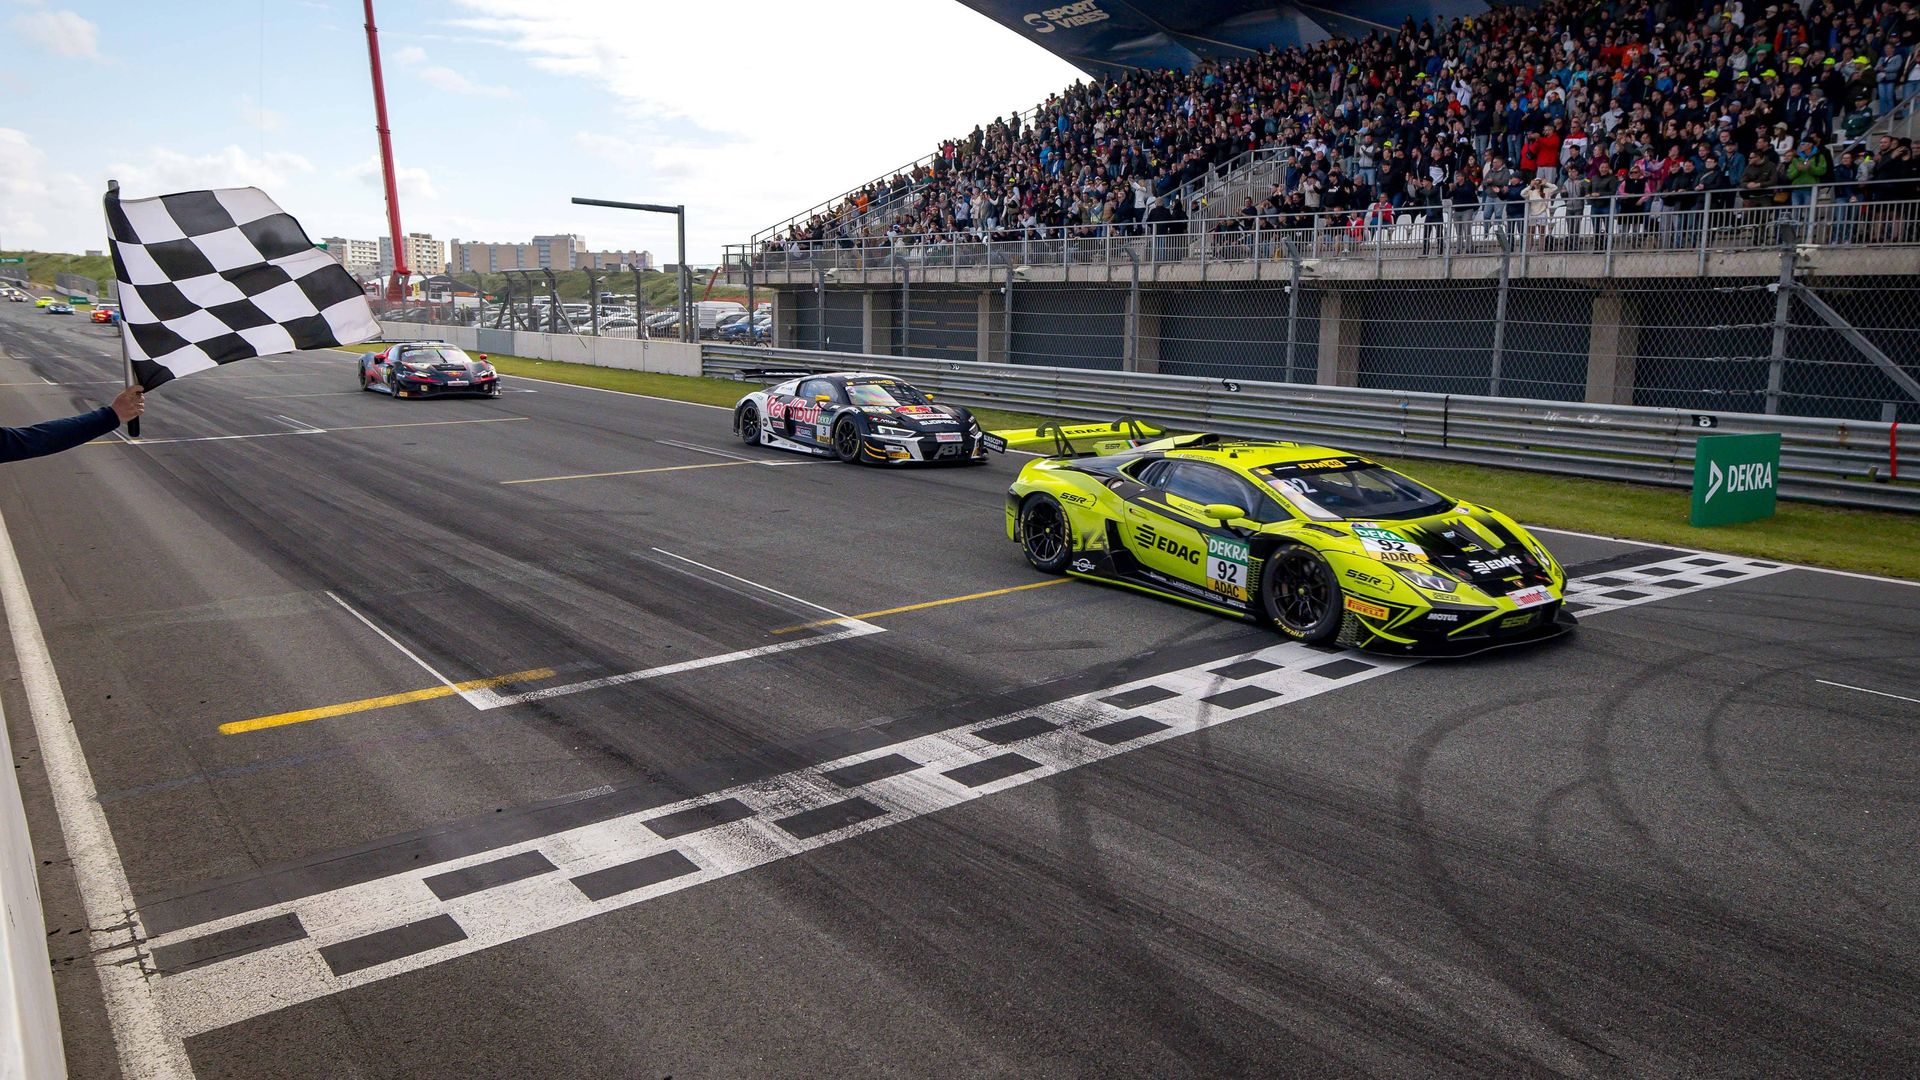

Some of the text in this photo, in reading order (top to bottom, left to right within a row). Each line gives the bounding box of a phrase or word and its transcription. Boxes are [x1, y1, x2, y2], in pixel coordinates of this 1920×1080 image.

[1042, 0, 1096, 20] SPORT
[1055, 10, 1110, 28] VIBES
[1698, 416, 1711, 427] 8
[822, 427, 827, 436] 3
[1298, 462, 1328, 470] DTM
[1727, 461, 1773, 493] DEKRA
[1060, 492, 1087, 504] SSR
[1156, 535, 1201, 566] EDAG
[1208, 538, 1249, 563] DEKRA
[1377, 539, 1409, 552] 92
[1381, 552, 1417, 563] ADAC
[1488, 555, 1523, 570] EDAG
[1217, 560, 1238, 583] 92
[1345, 569, 1382, 586] SSR
[1214, 580, 1240, 598] ADAC
[1347, 598, 1385, 618] PIRELLI
[1427, 612, 1459, 622] MOTUL
